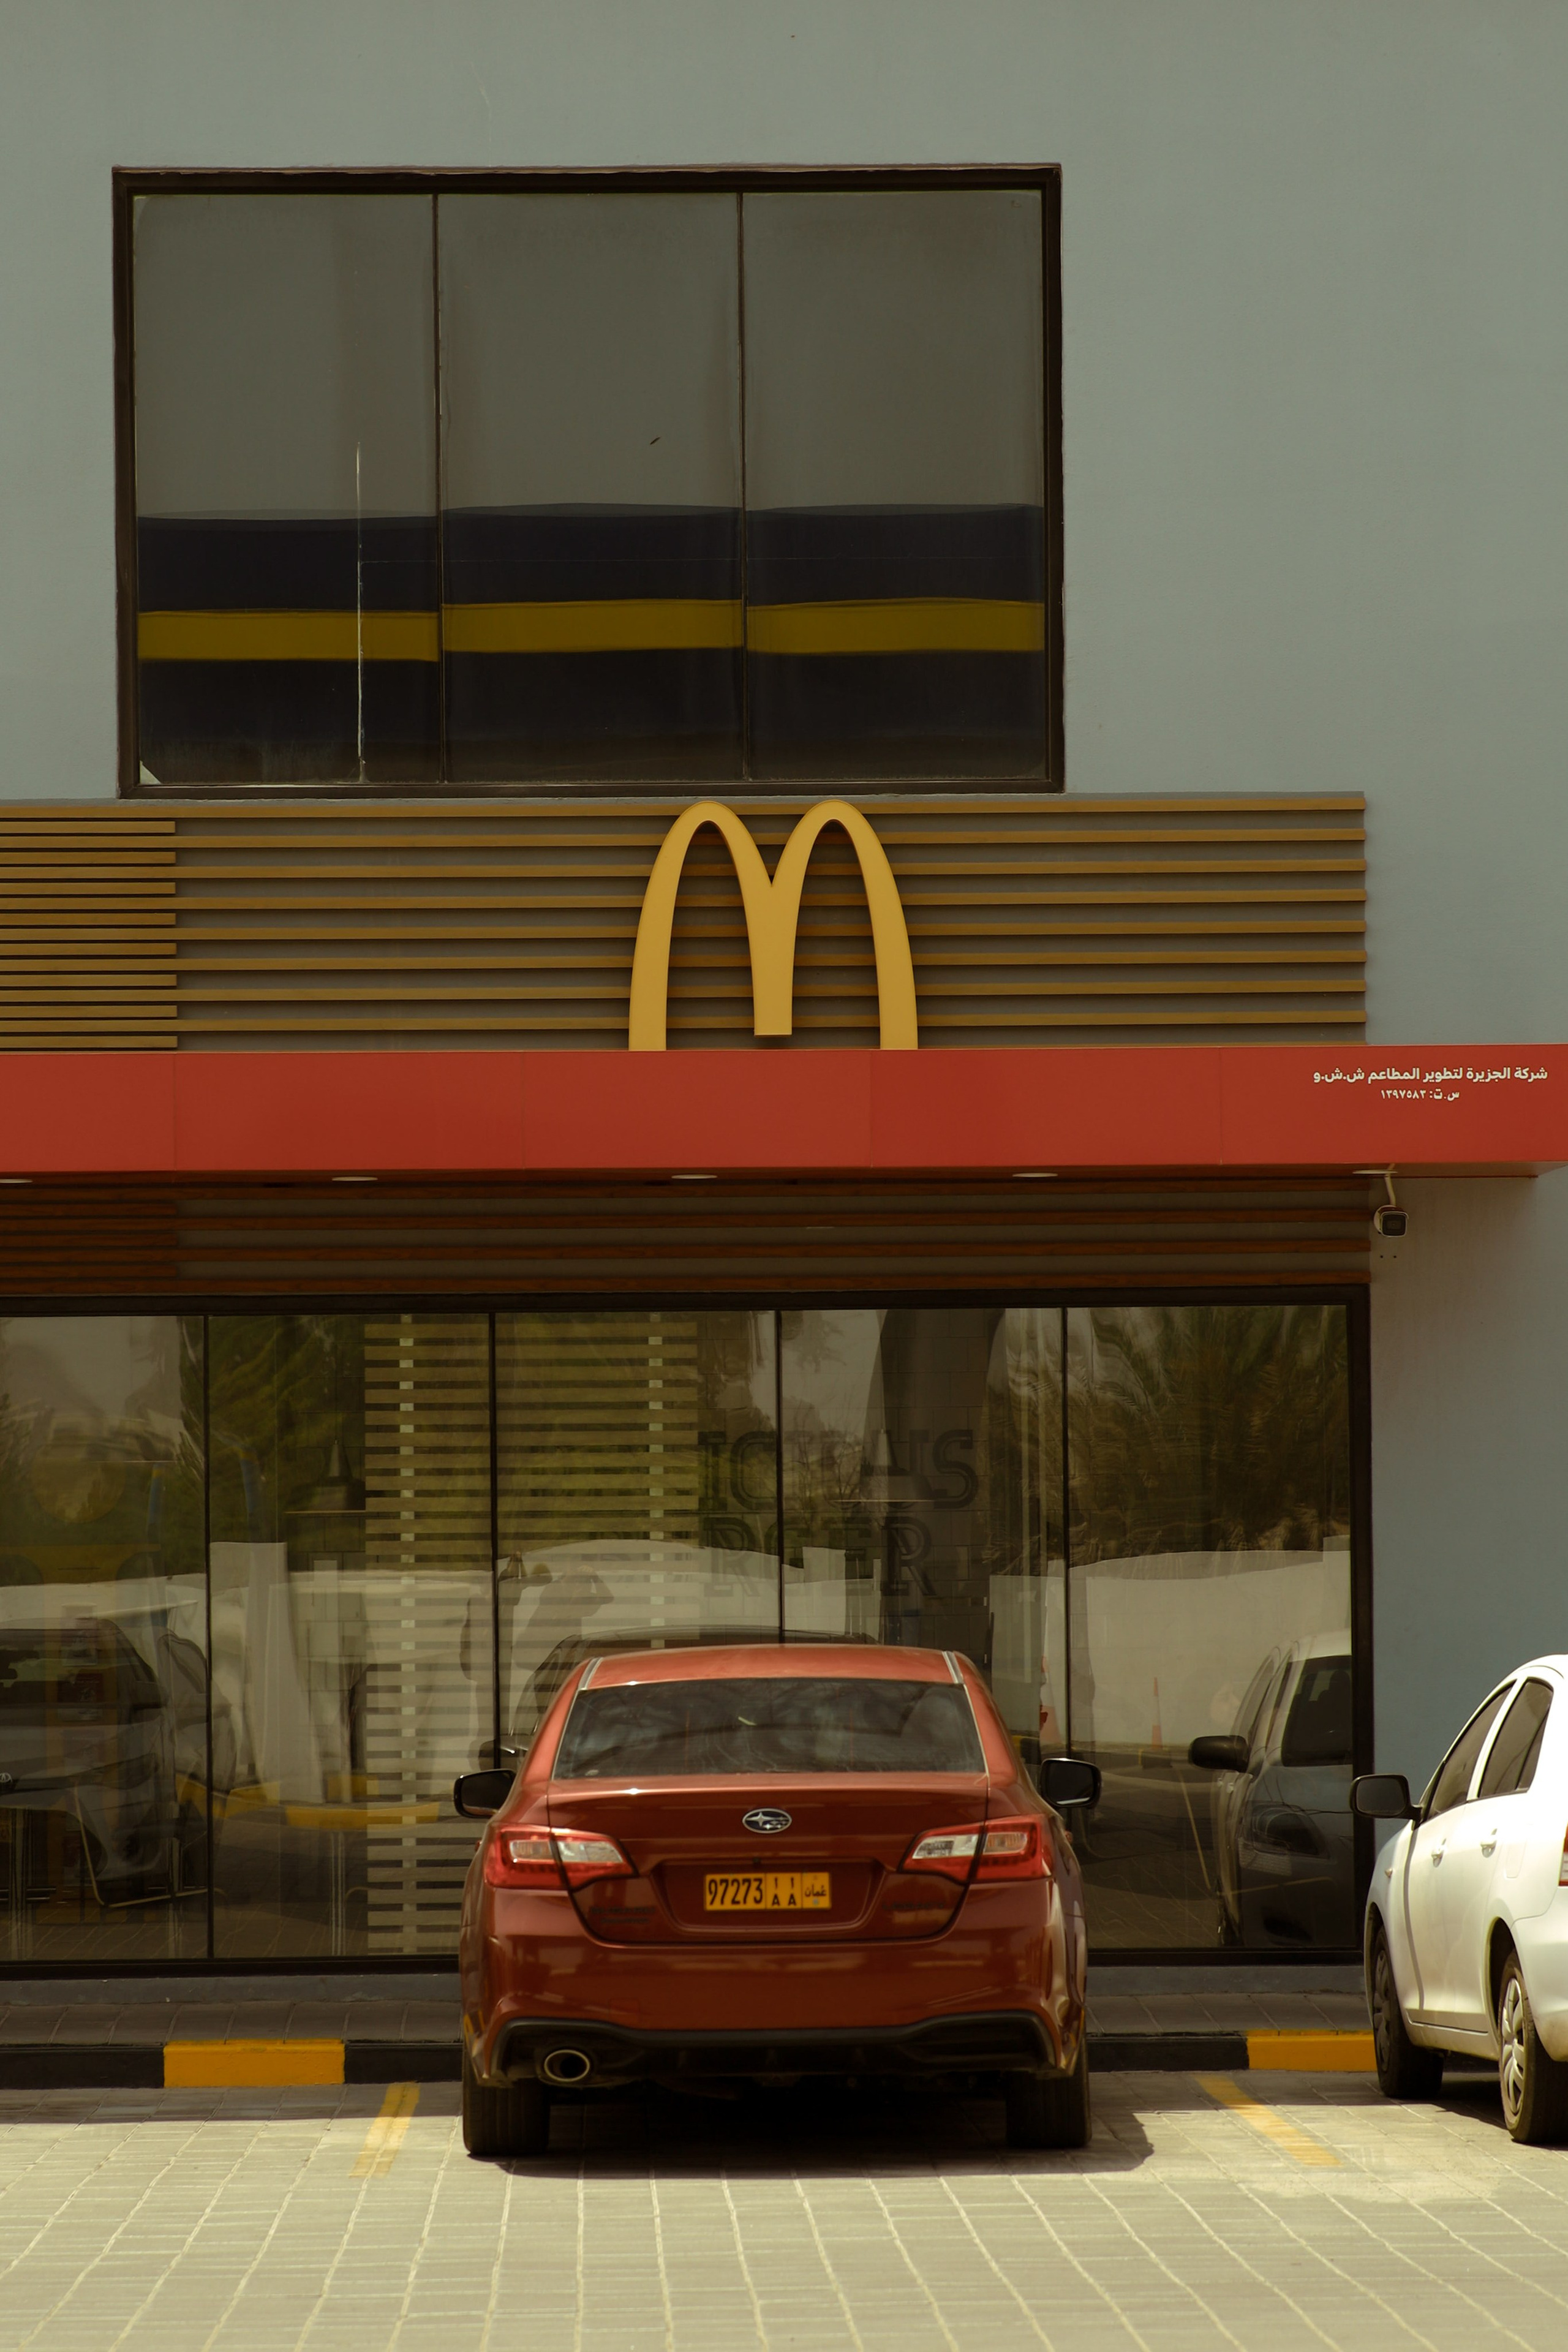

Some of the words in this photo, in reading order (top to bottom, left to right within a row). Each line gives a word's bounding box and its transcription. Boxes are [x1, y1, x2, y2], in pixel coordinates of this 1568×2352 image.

[1368, 1067, 1420, 1084] المطاعم
[1422, 1067, 1463, 1082] لتطوير
[1466, 1067, 1511, 1082] الجزيرة
[1513, 1067, 1548, 1082] شركة
[708, 1877, 764, 1906] 97273
